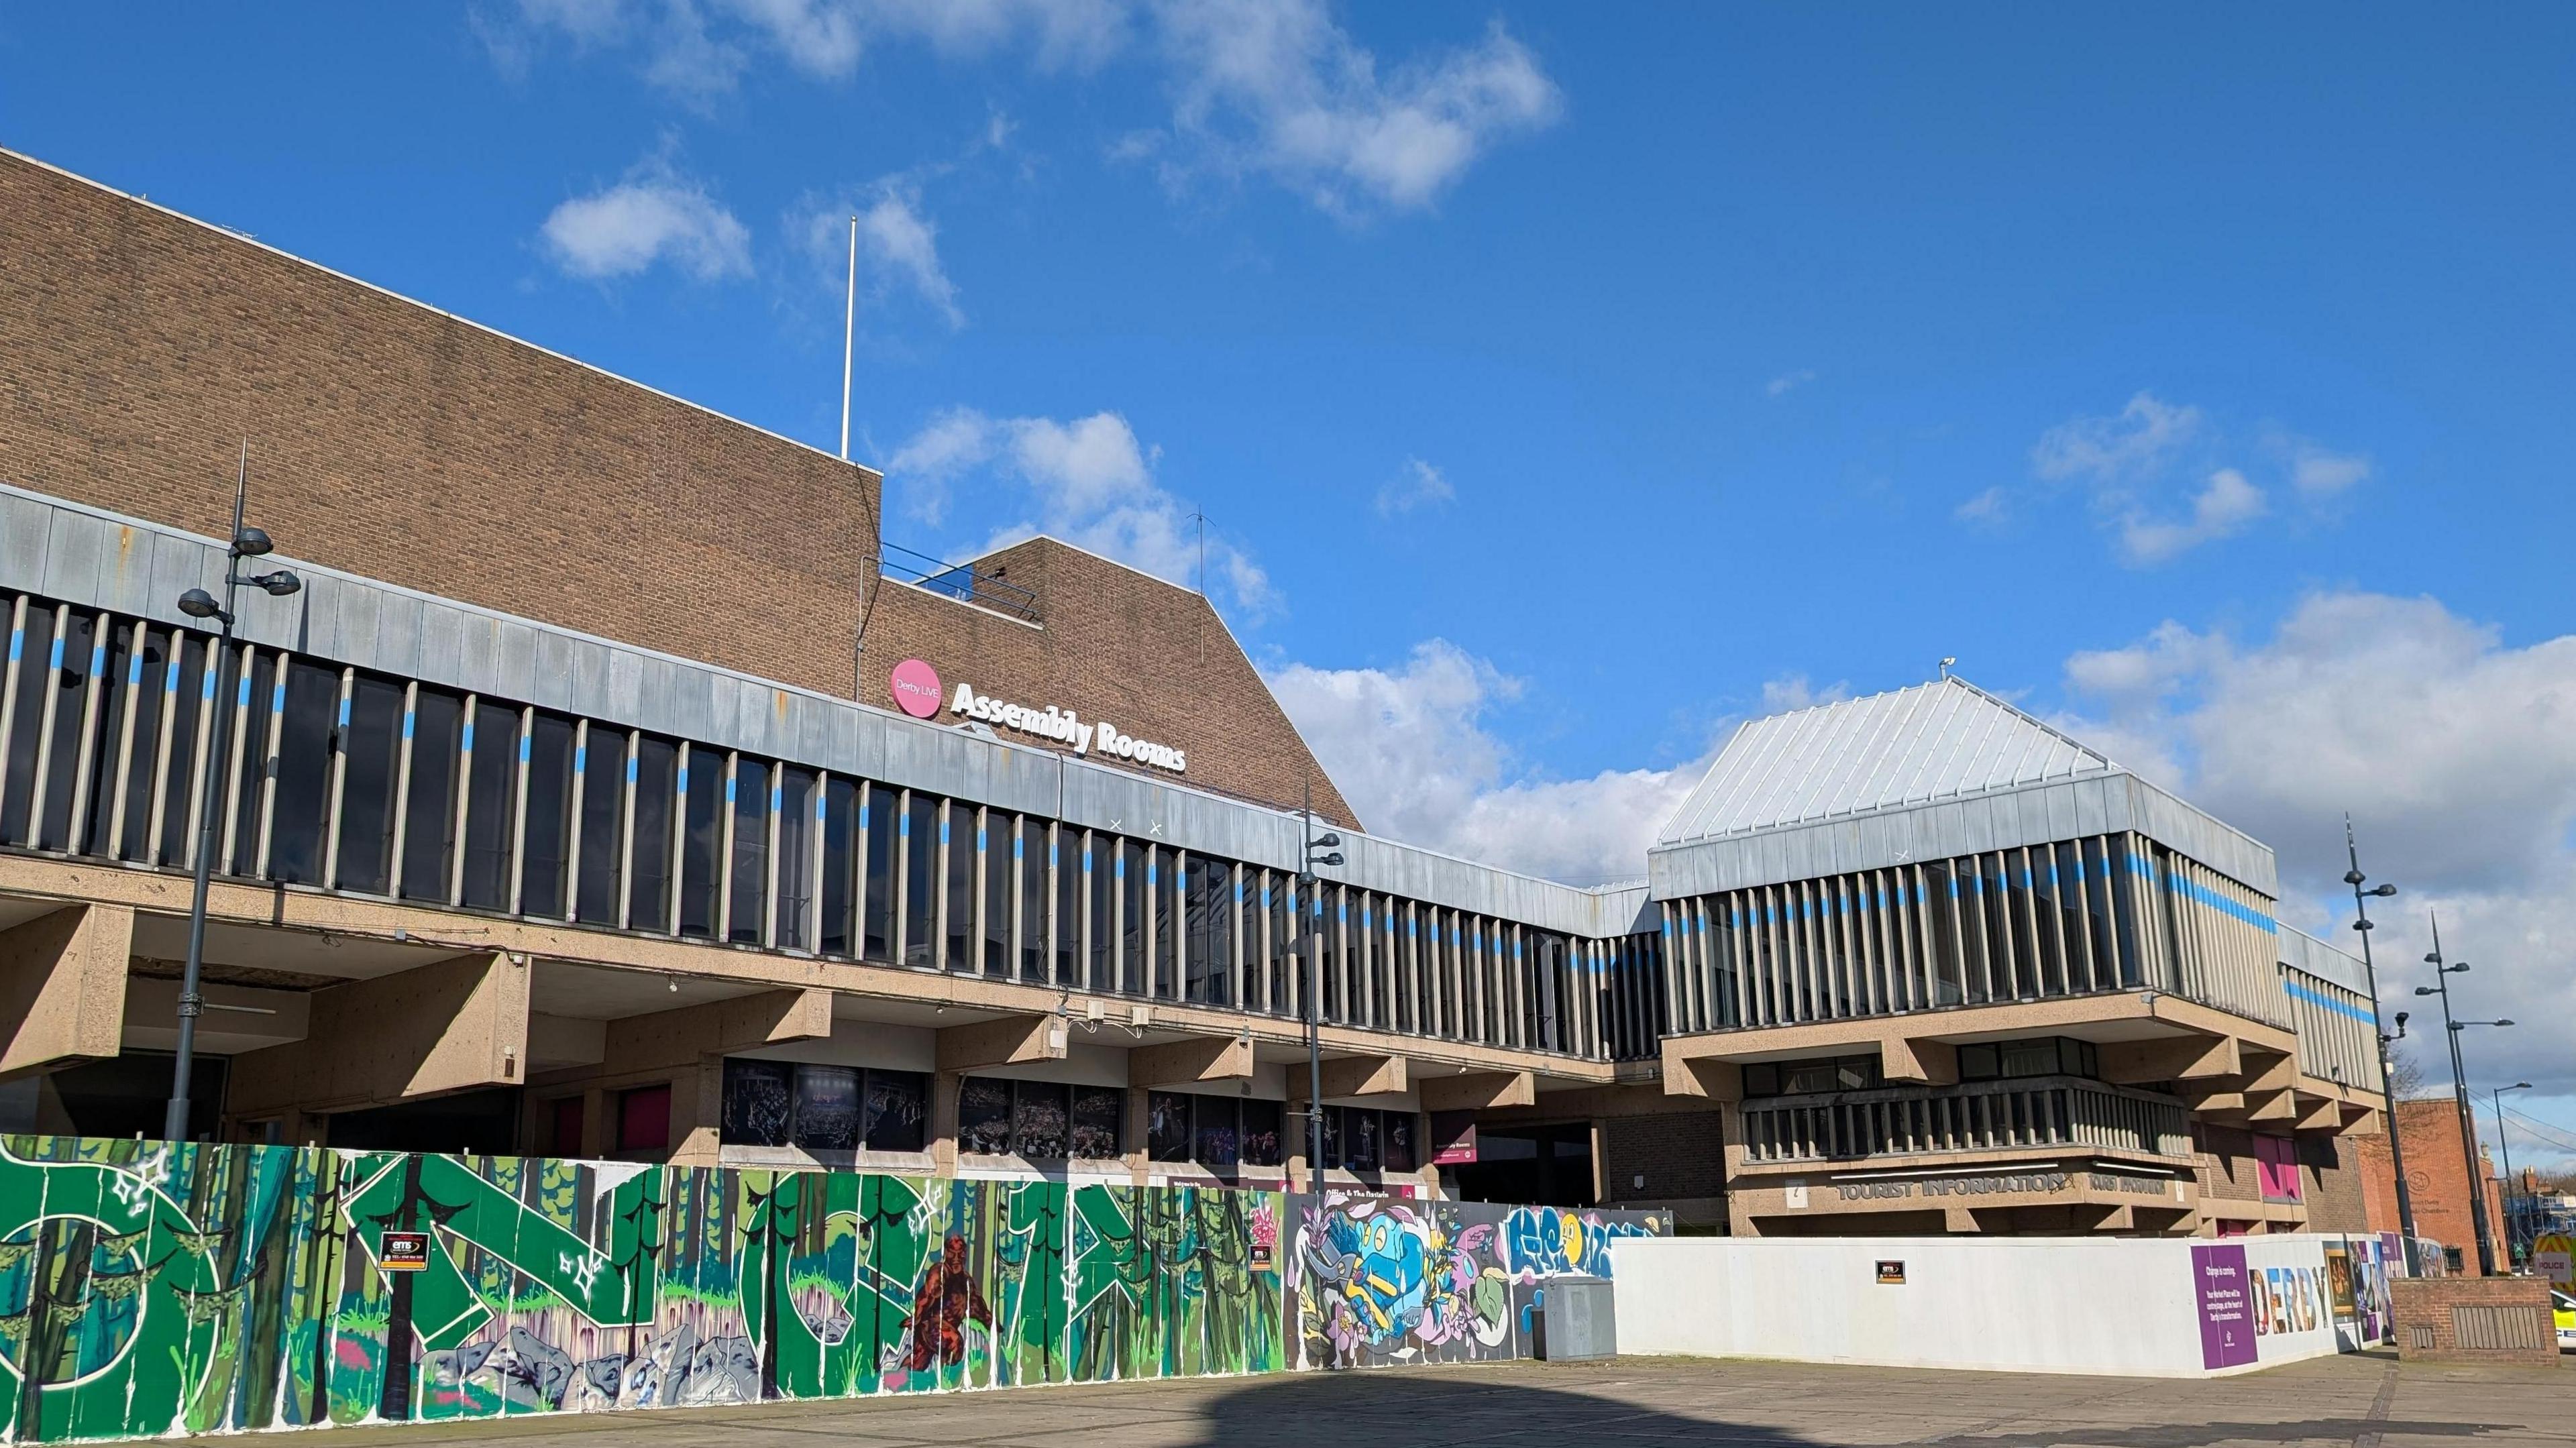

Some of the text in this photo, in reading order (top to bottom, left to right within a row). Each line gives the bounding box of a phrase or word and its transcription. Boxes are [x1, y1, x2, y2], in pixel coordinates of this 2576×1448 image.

[896, 679, 939, 698] Derby LIVE
[950, 683, 1186, 772] Assembly Rooms
[1837, 1172, 2065, 1201] TOURIST INFORMATION
[2088, 1174, 2166, 1196] TOURIST INFORMATION
[392, 1241, 411, 1249] ems
[2539, 1262, 2565, 1270] POLICE
[2249, 1266, 2328, 1336] DERBY
